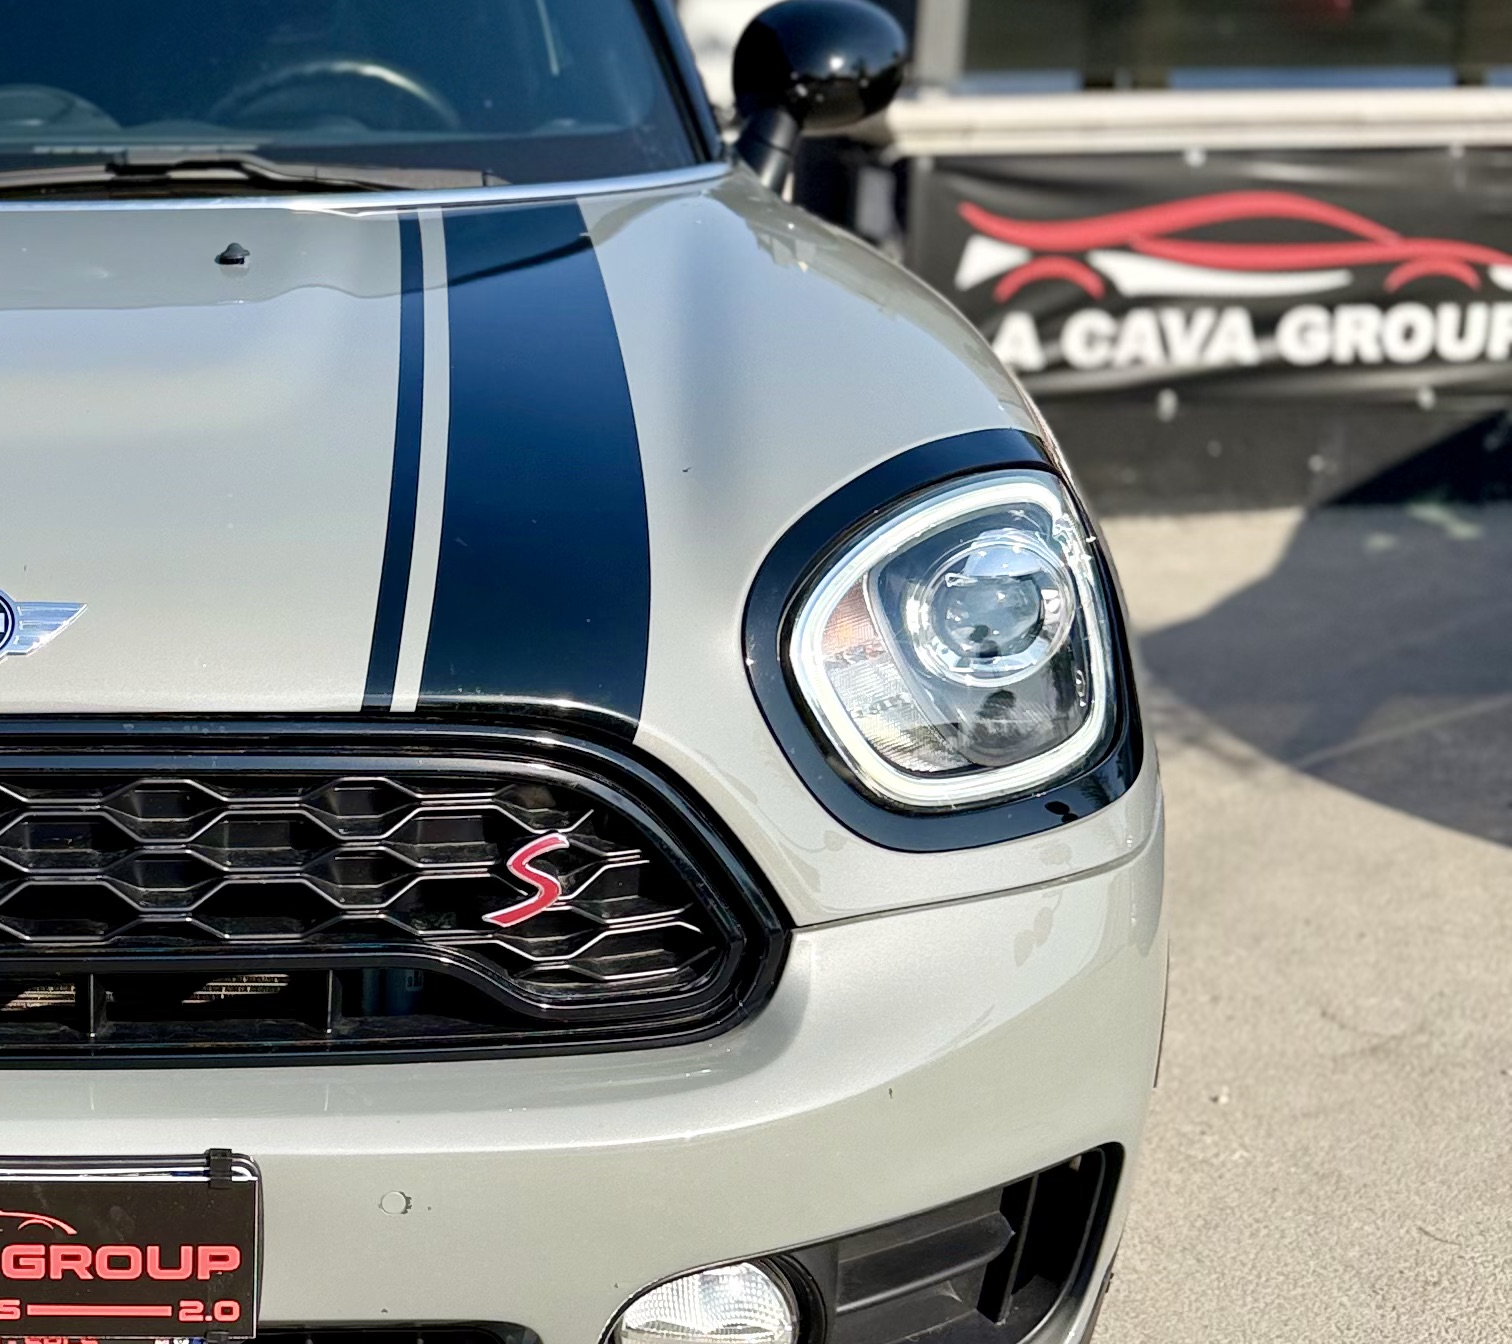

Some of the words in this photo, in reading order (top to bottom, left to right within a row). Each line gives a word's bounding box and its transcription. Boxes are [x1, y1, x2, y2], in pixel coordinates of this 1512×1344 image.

[991, 309, 1048, 372] A
[1060, 303, 1261, 370] CAVA
[482, 832, 570, 928] S
[0, 1243, 242, 1281] GROUP
[177, 1299, 241, 1323] 2.0
